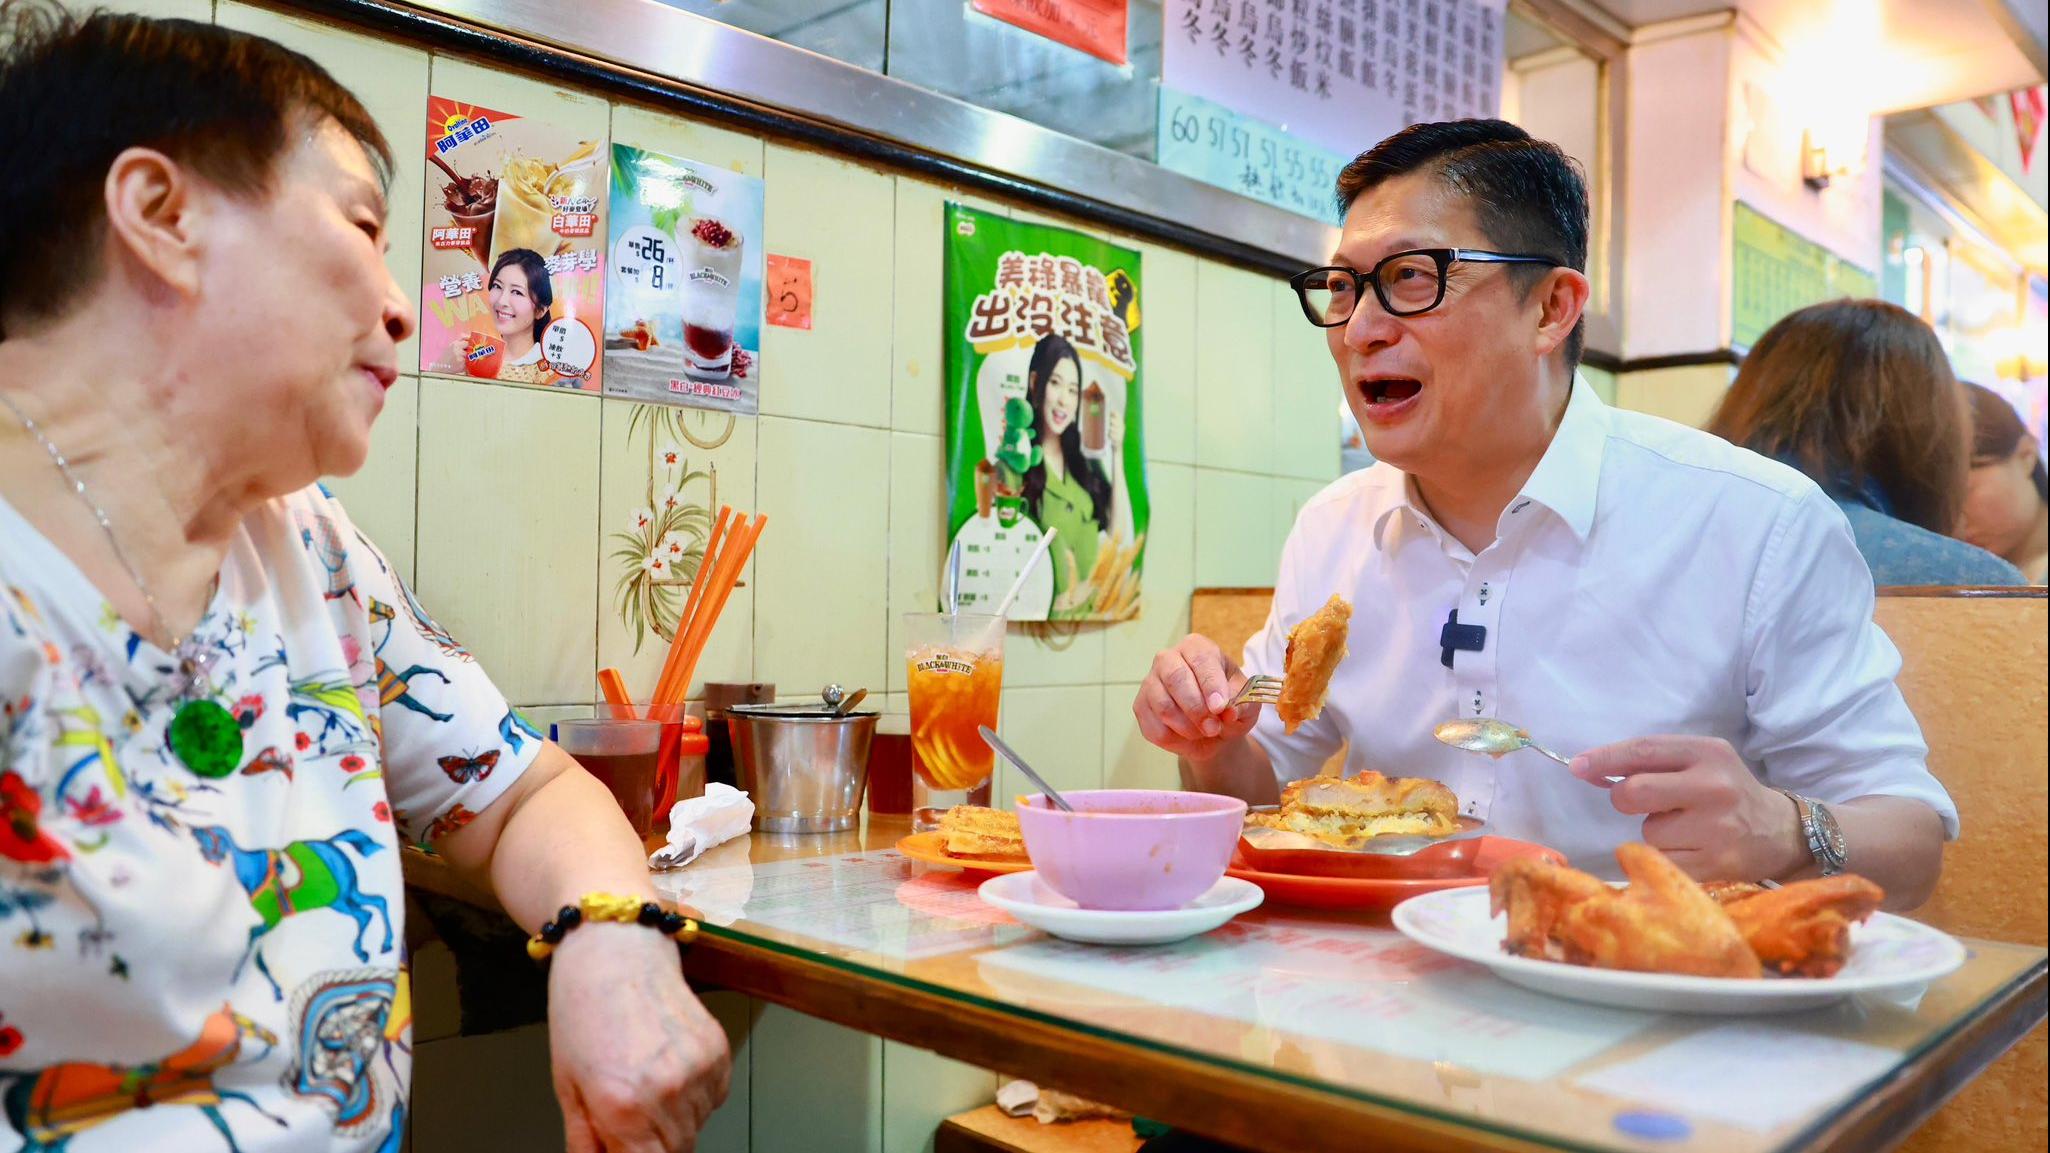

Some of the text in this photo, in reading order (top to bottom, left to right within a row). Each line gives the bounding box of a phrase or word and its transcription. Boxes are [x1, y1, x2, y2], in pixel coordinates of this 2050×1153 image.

[436, 117, 491, 154] 阿華田
[1172, 106, 1200, 144] 60
[552, 213, 591, 228] 白華田
[432, 227, 471, 241] 阿華田
[544, 249, 598, 275] 麥芽學
[641, 236, 665, 264] 26
[440, 271, 482, 298] 營養
[917, 660, 972, 674] BLACK&WHITE
